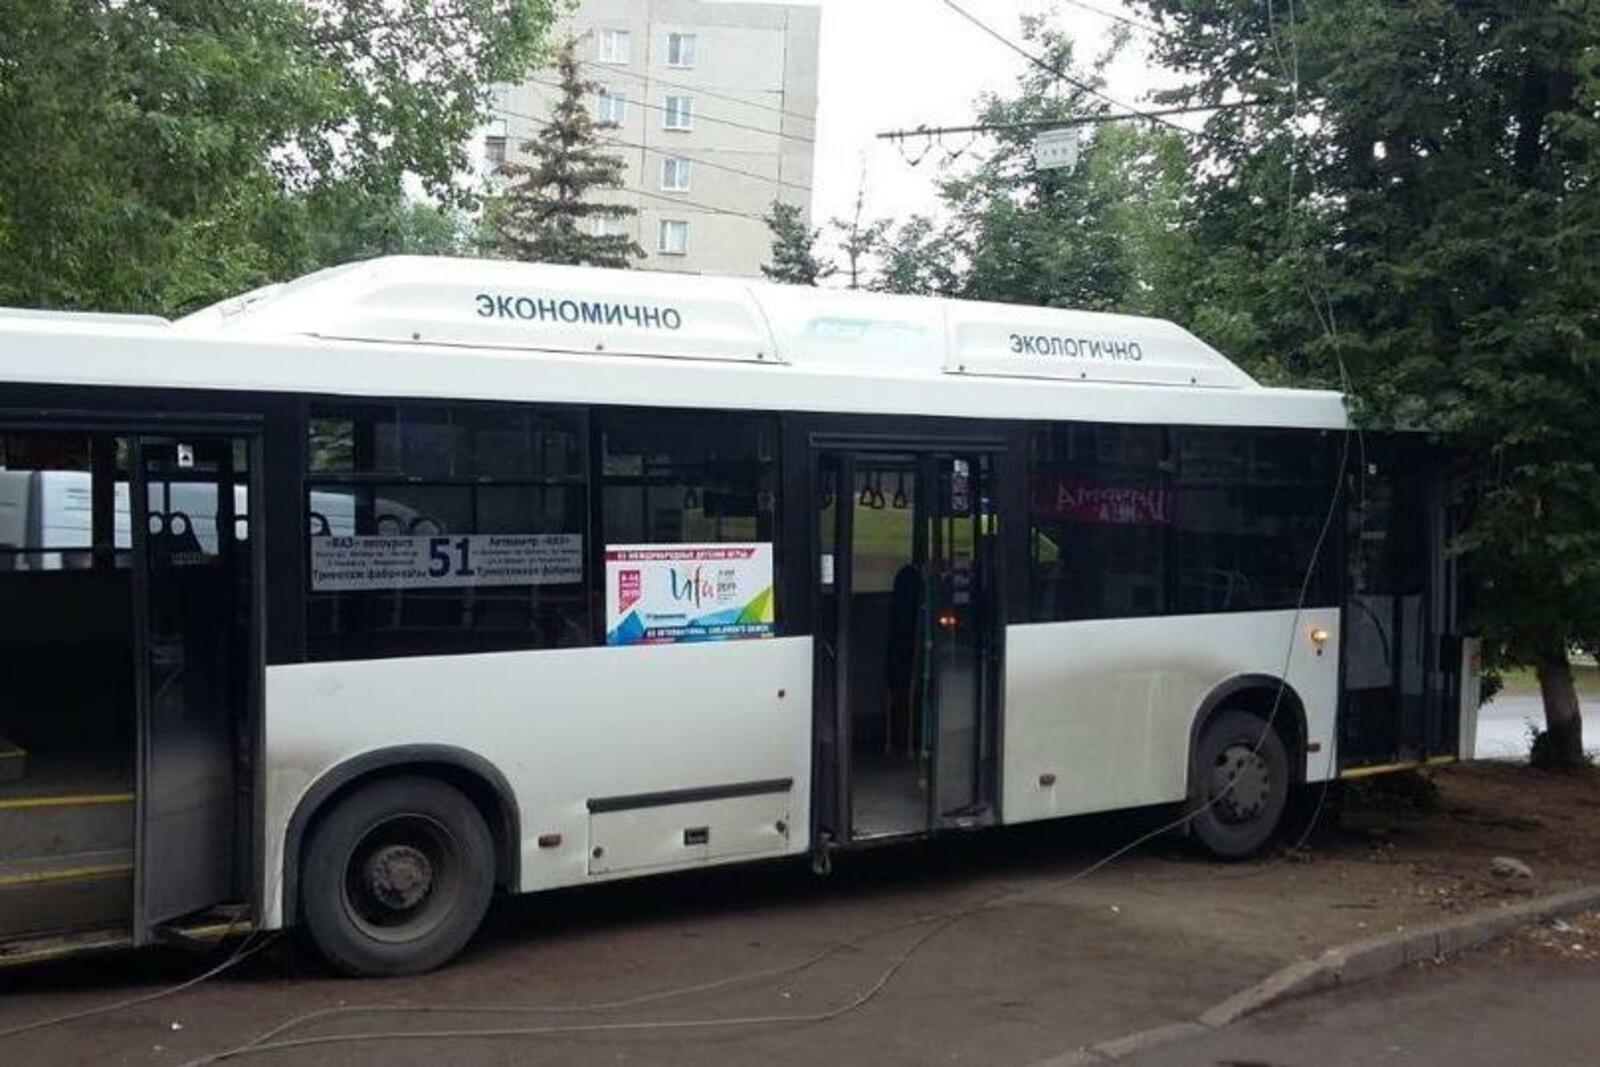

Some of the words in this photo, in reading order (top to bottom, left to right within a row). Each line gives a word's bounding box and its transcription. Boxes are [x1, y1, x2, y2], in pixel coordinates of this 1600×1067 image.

[475, 294, 681, 330] ЭКОНОМИЧНО
[1009, 333, 1142, 361] ЭКОЛОГИЧНО
[429, 538, 474, 578] 51
